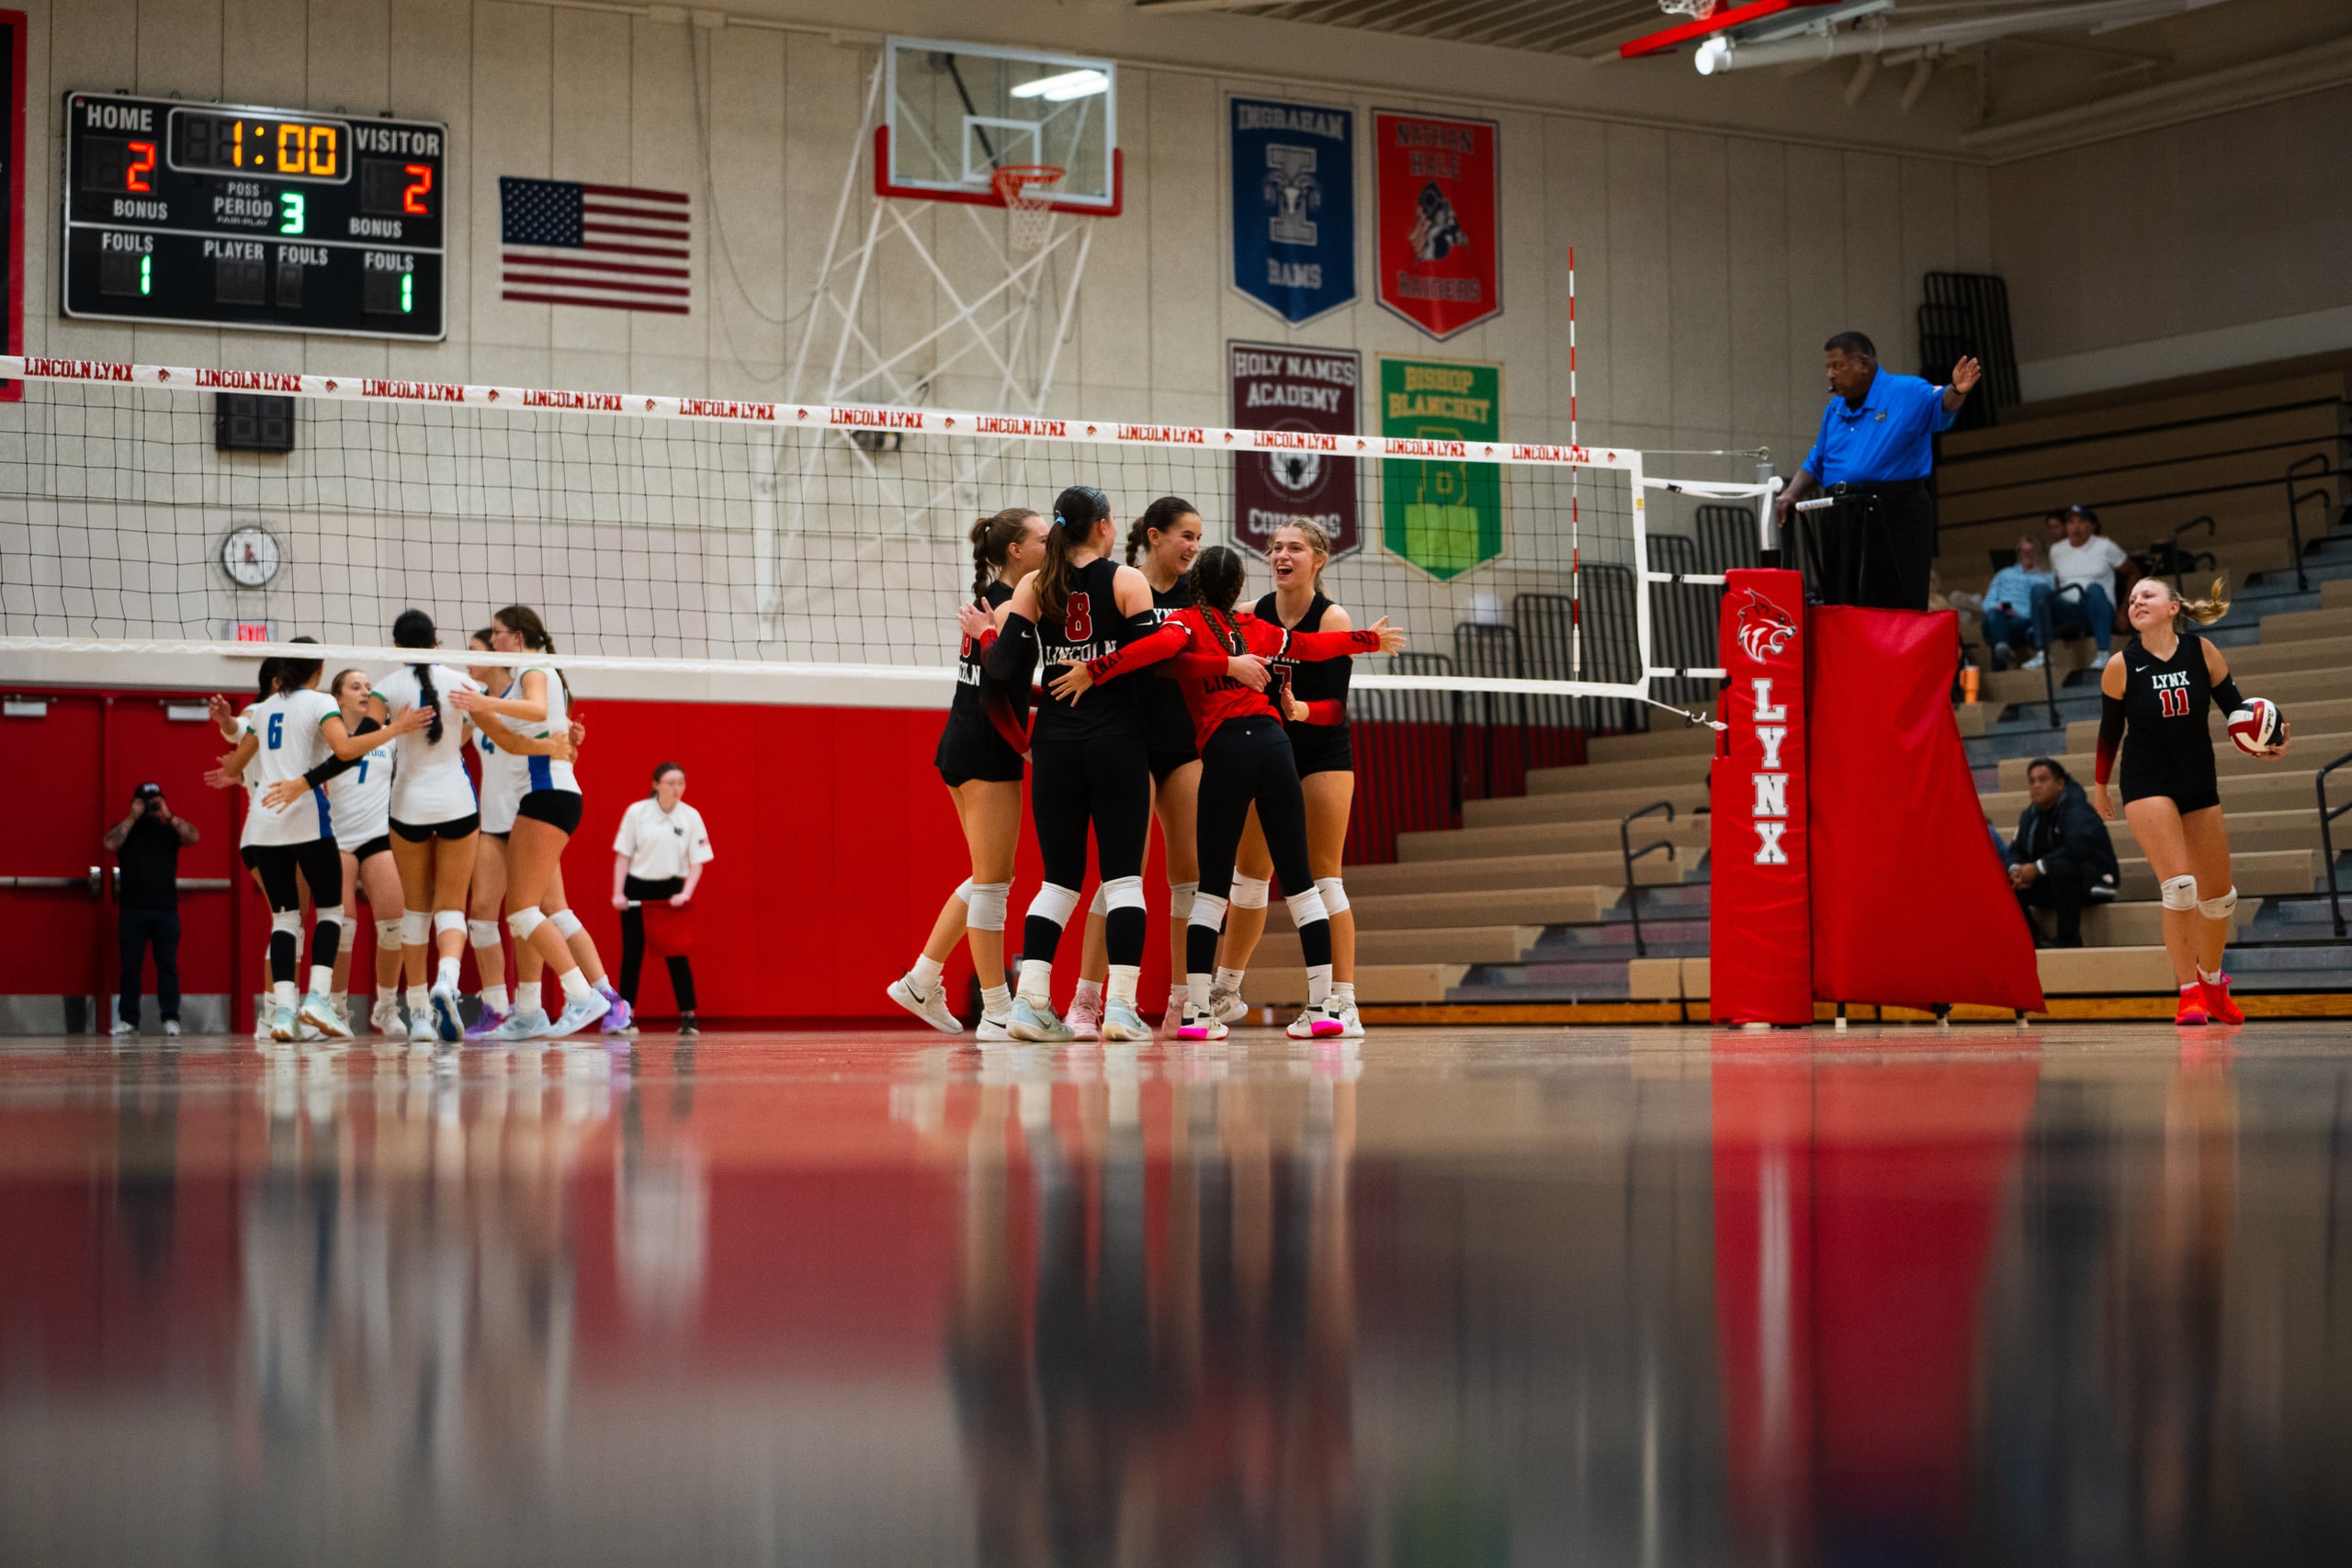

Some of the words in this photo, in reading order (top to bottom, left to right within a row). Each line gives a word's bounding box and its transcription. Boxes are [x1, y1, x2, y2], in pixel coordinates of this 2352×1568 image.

[86, 104, 153, 131] HOME
[232, 119, 336, 175] 1:00
[355, 127, 441, 156] VISITOR
[126, 141, 155, 192] 2
[227, 181, 260, 198] POSS
[402, 164, 433, 214] 2
[113, 198, 168, 220] BONUS
[212, 197, 274, 218] PERIOD
[280, 191, 305, 234] 3
[102, 232, 154, 252] FOULS
[349, 217, 402, 239] BONUS
[203, 240, 265, 261] PLAYER
[278, 244, 329, 266] FOULS
[364, 251, 414, 272] FOULS
[141, 254, 151, 295] 1
[1267, 257, 1323, 290] RAMS
[401, 273, 413, 313] 1
[1235, 352, 1280, 378] HOLY
[1286, 356, 1355, 386] NAMES
[1404, 366, 1475, 394] BISHOP
[1246, 383, 1341, 412] ACADEMY
[1388, 392, 1491, 424] BLANCHET
[1065, 591, 1093, 642] 8
[1273, 664, 1293, 694] 7
[2152, 671, 2190, 689] LYNX
[2159, 687, 2189, 717] 11
[267, 713, 284, 750] 6
[1752, 678, 1789, 864] LYNX
